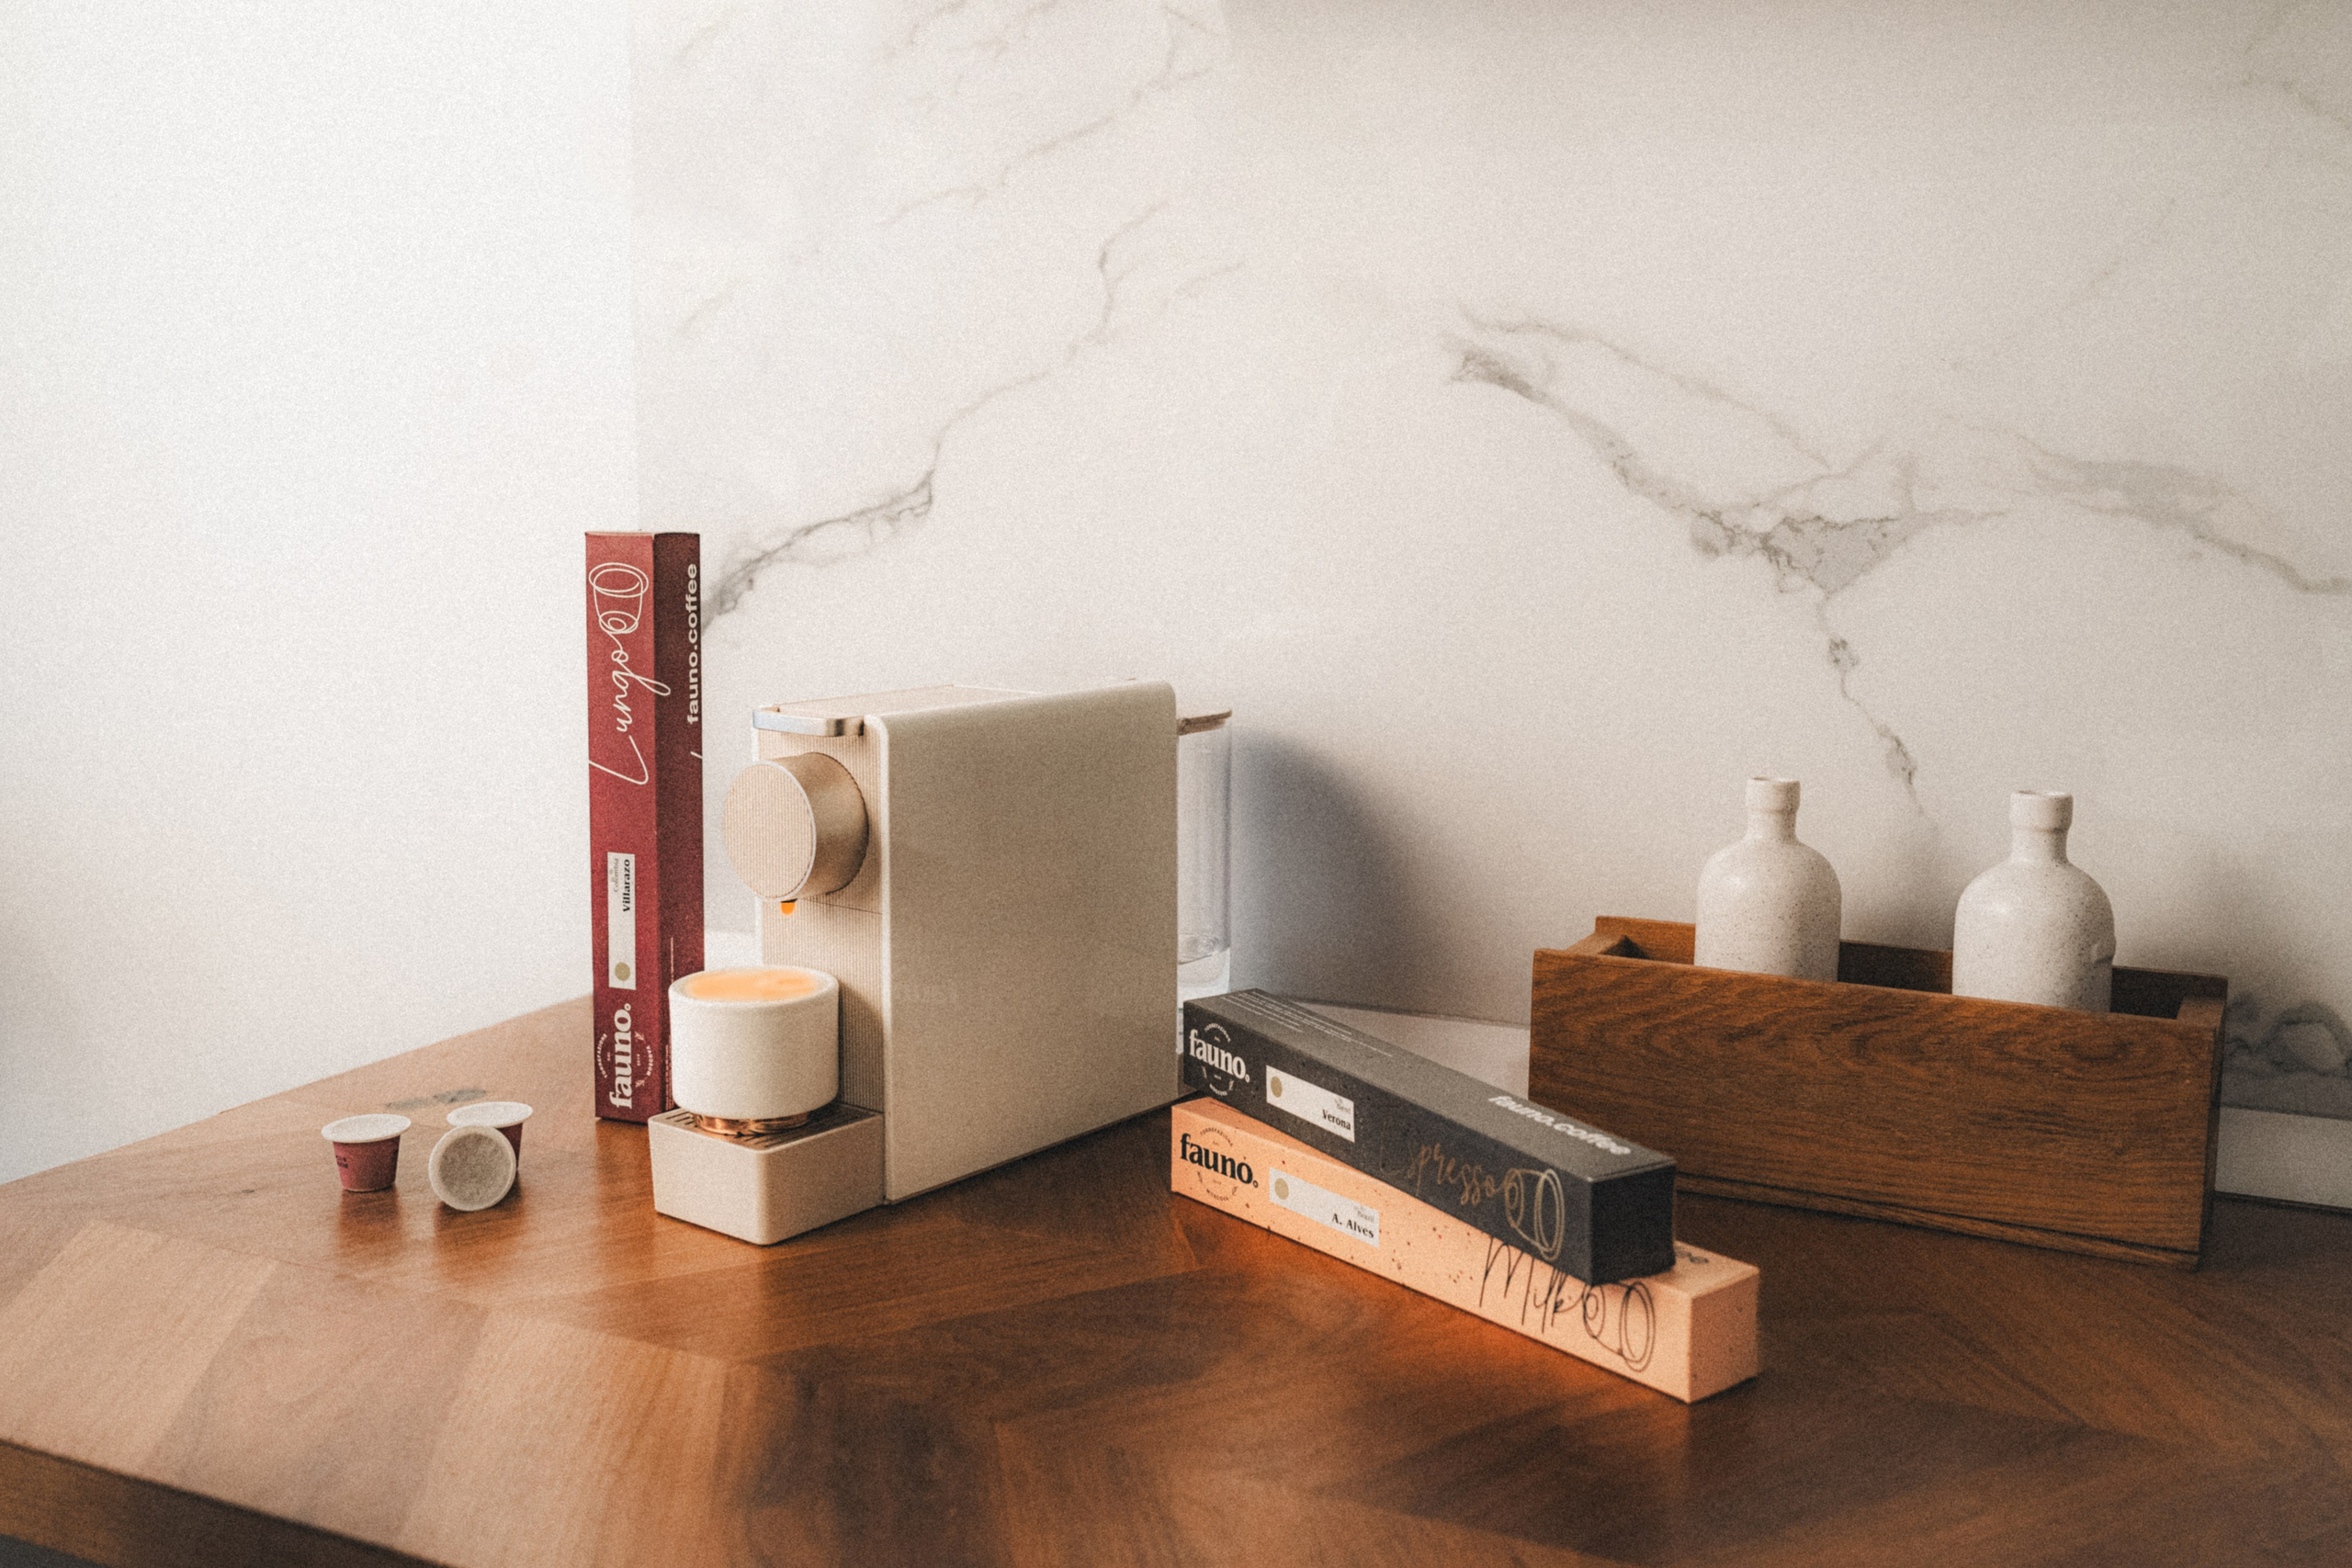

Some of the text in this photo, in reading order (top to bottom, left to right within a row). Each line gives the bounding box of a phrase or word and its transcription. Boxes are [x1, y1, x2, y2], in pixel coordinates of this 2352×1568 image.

[686, 563, 698, 725] fauno.coffee
[622, 858, 631, 912] Villarazo
[1321, 1109, 1351, 1131] Verona
[1487, 1094, 1632, 1156] fauno.coffee
[1331, 1213, 1374, 1238] A. Alves
